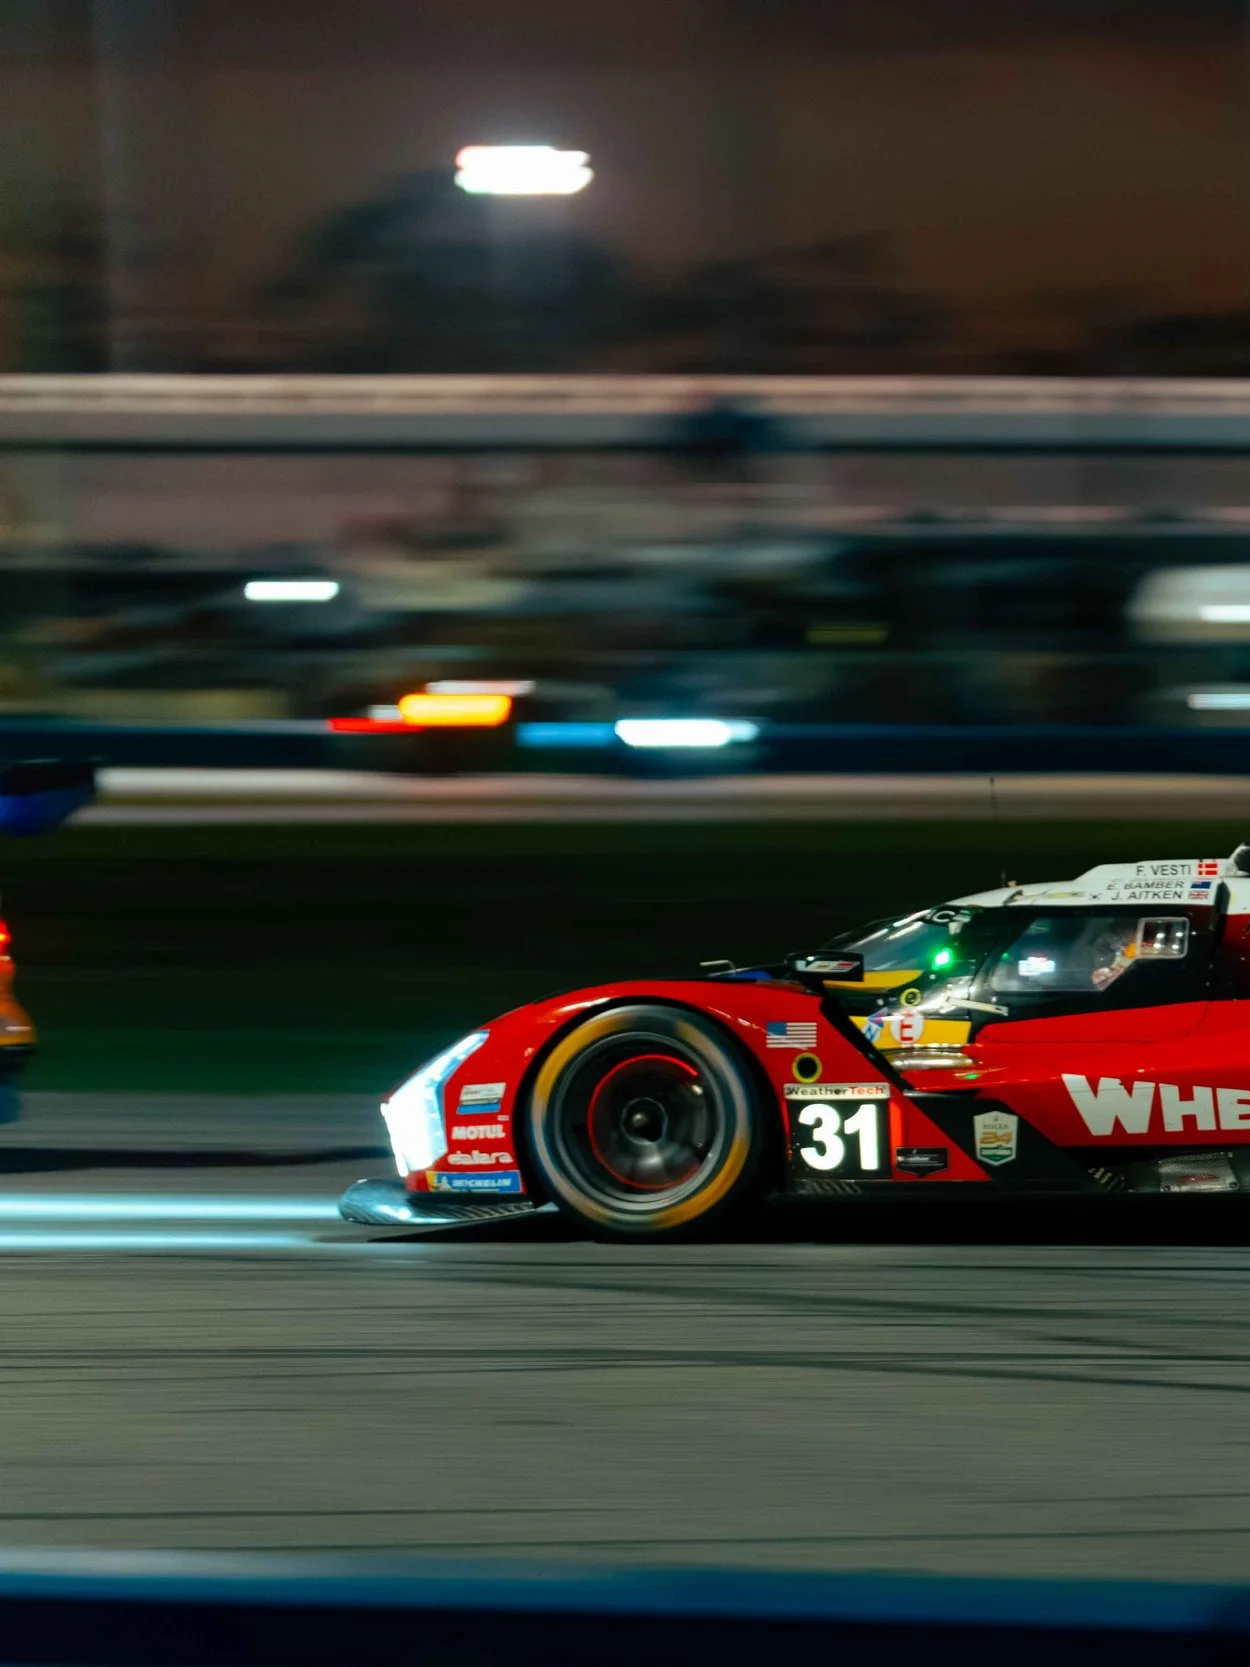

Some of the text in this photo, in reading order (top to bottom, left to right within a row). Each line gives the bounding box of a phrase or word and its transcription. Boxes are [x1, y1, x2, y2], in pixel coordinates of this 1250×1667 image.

[1136, 864, 1191, 876] F. VESTI
[1124, 880, 1185, 890] BAMBER
[1111, 890, 1183, 901] J. AITKEN
[451, 1124, 506, 1140] MOTUL
[798, 1103, 879, 1171] 31
